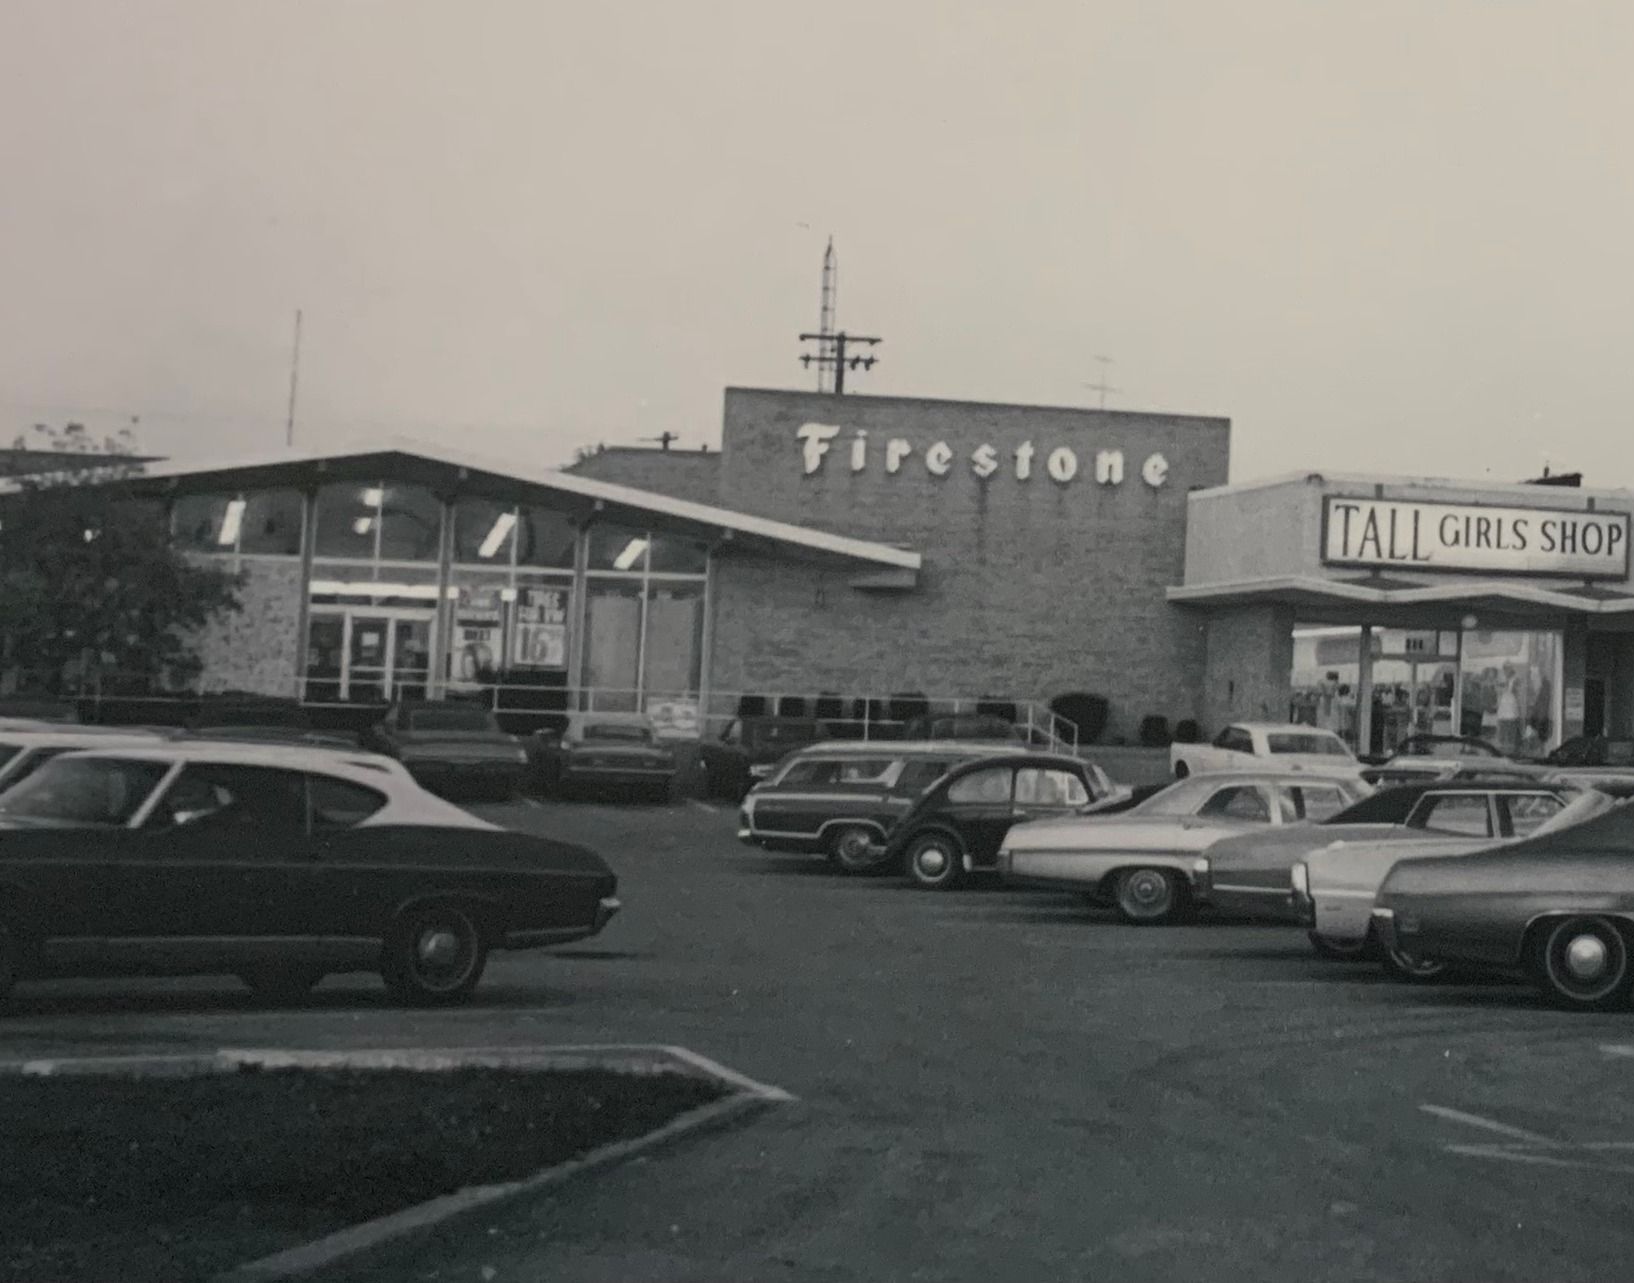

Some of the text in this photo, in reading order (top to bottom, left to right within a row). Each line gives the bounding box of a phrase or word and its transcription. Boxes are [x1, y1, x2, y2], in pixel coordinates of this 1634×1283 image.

[796, 422, 1169, 487] Firestone
[1334, 505, 1623, 562] TALL GIRLS SHOP
